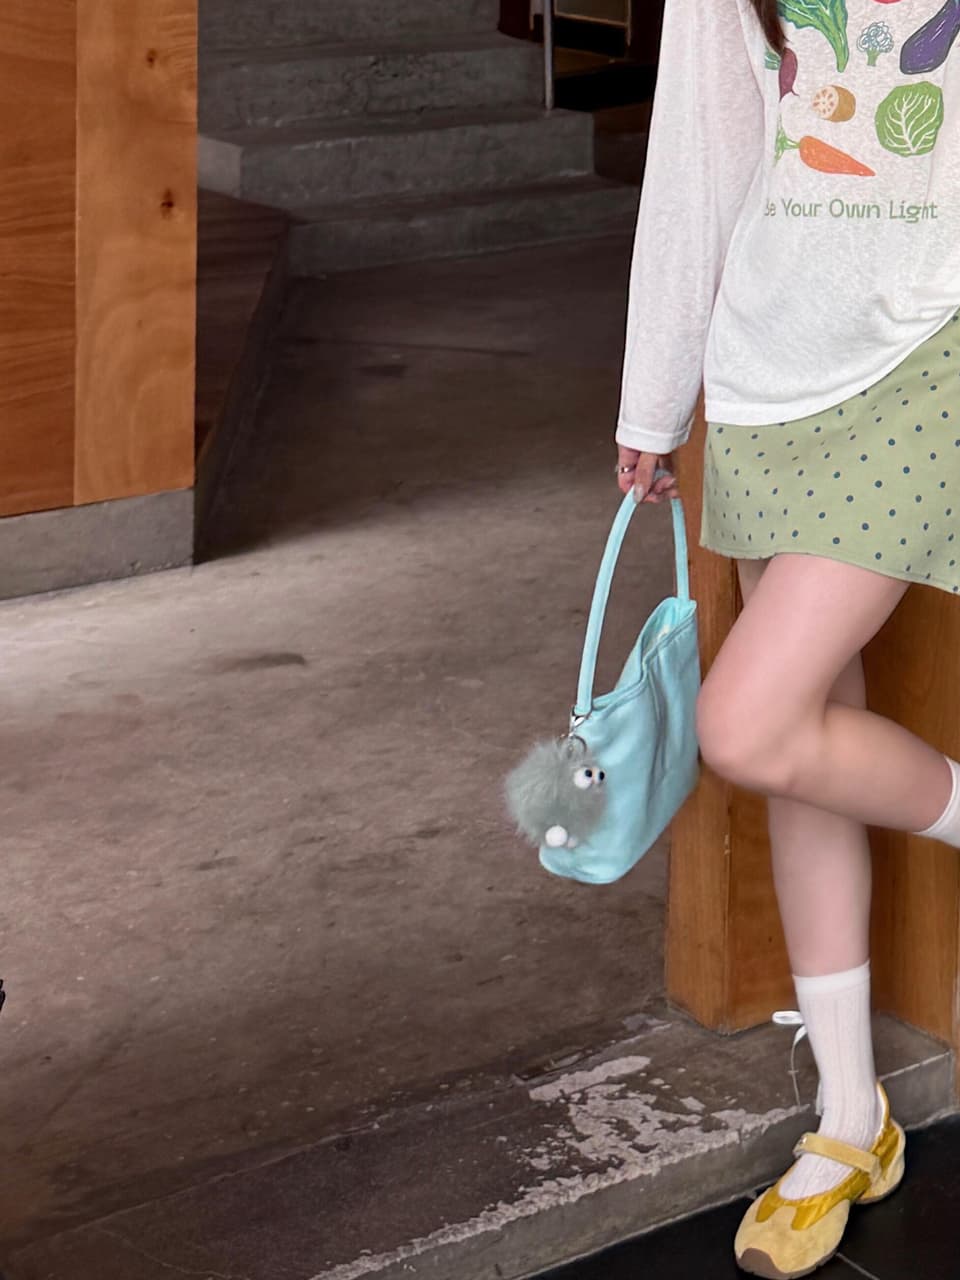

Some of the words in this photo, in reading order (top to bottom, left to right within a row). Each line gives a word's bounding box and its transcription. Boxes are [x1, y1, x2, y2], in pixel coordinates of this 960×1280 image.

[781, 198, 822, 217] Your
[829, 198, 881, 219] Own
[889, 200, 938, 223] Light
